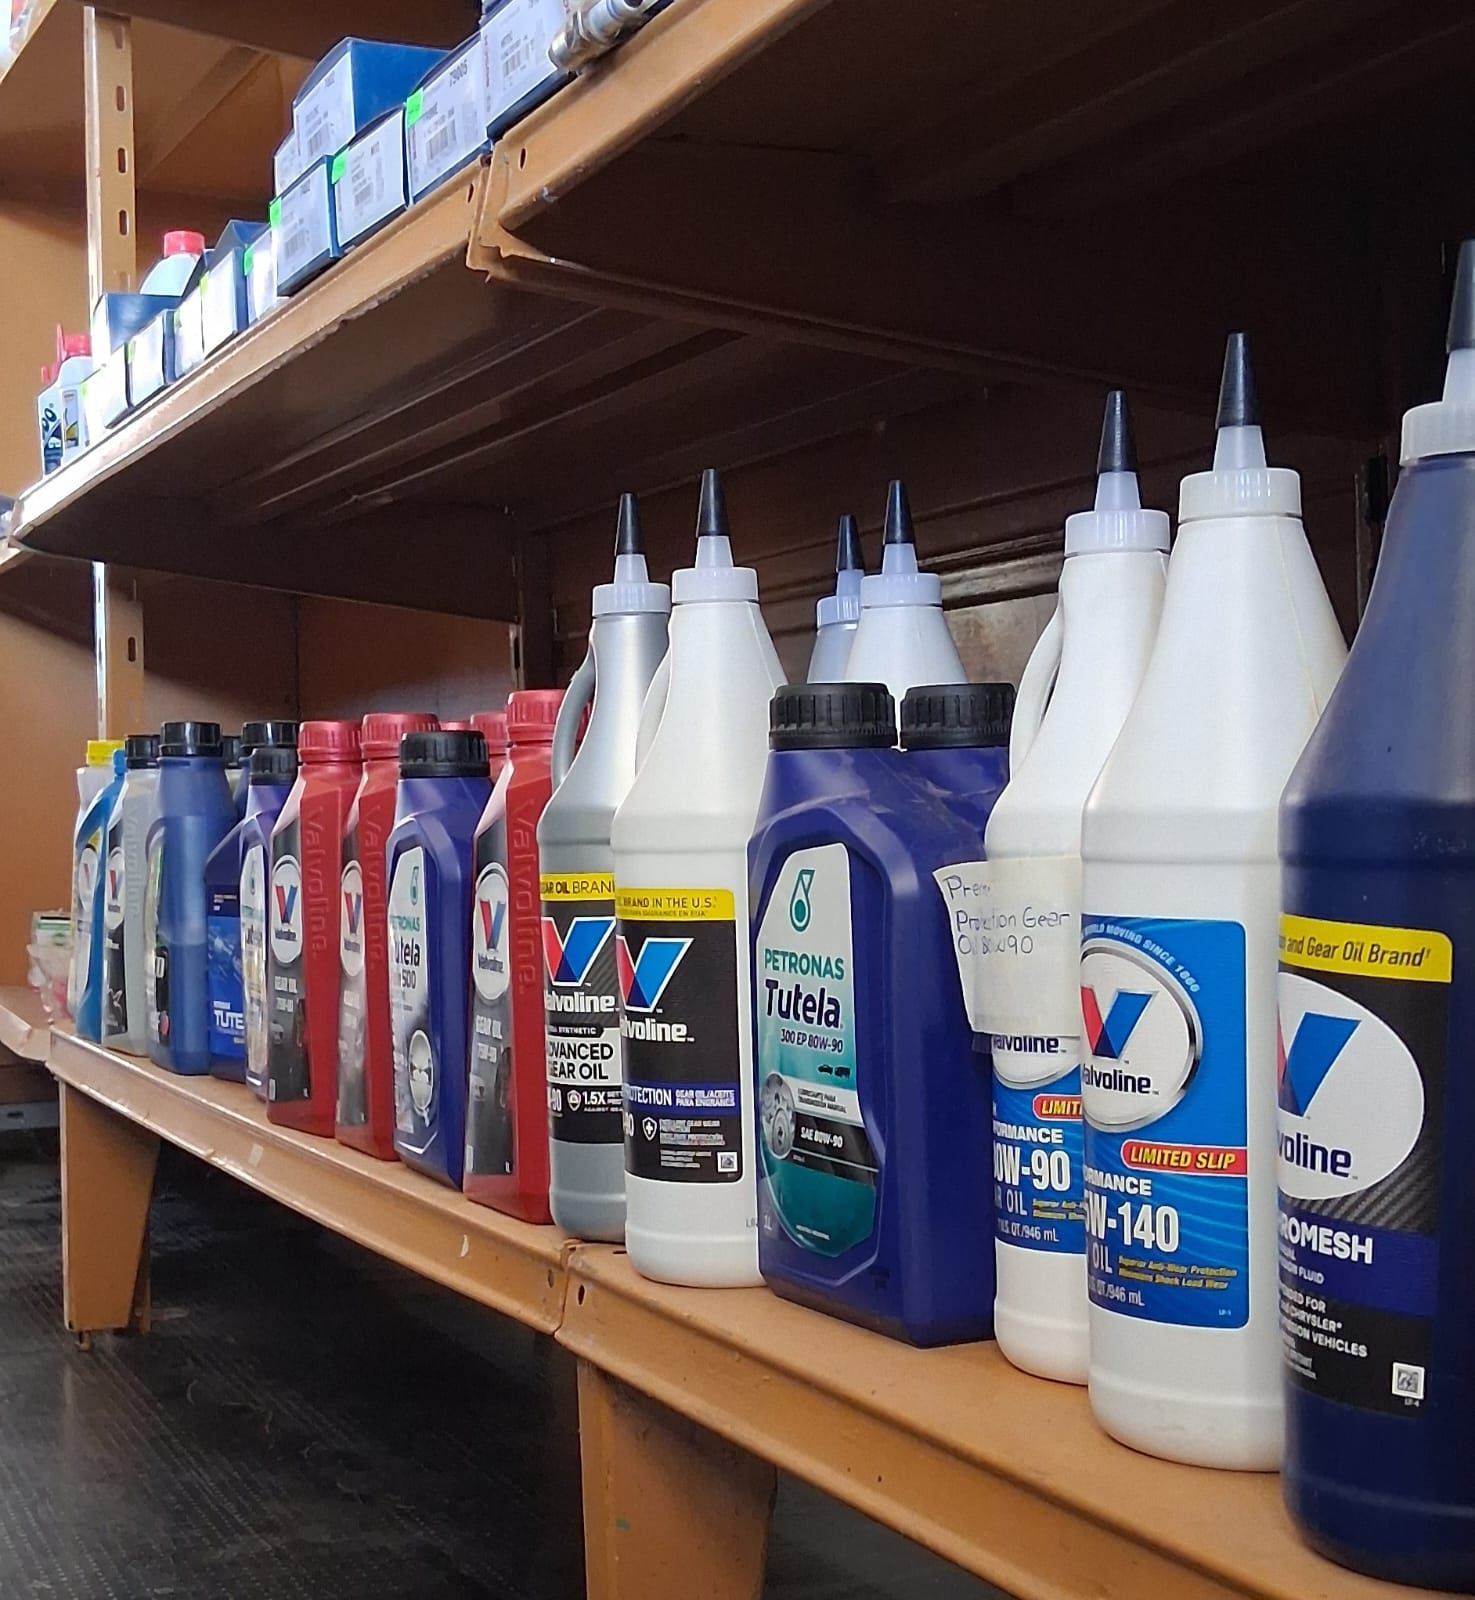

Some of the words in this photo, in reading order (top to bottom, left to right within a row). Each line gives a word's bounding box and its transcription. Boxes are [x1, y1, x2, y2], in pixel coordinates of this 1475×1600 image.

[556, 881, 570, 894] OIL
[572, 880, 616, 894] BRAN
[623, 896, 650, 908] BRAND
[652, 897, 663, 908] IN
[666, 897, 687, 908] THE
[1022, 906, 1070, 928] Gear
[1106, 923, 1143, 945] MOVING
[1142, 939, 1176, 967] SINCE
[1307, 937, 1340, 960] Gear
[1342, 941, 1365, 963] Oil
[764, 947, 845, 981] PETRONAS
[401, 969, 417, 990] 500
[765, 978, 842, 1029] Tutela
[781, 1028, 796, 1045] 300
[796, 1031, 808, 1046] EP
[807, 1034, 844, 1054] 80W-90
[579, 1062, 609, 1080] OIL
[582, 1090, 607, 1106] 1.5X
[801, 1126, 814, 1142] SAE
[993, 1140, 1071, 1192] 0W-90
[1130, 1146, 1192, 1168] LIMITED
[1195, 1151, 1237, 1169] SLIP
[1006, 1187, 1028, 1216] OIL
[1092, 1242, 1113, 1275] OIL
[1189, 1265, 1238, 1278] Protection
[1298, 1266, 1325, 1285] FLUID
[1181, 1277, 1204, 1289] Load
[1205, 1279, 1229, 1290] Wear
[1128, 1289, 1146, 1307] mL
[1305, 1296, 1327, 1313] FOR
[1311, 1330, 1368, 1358] VEHICLES
